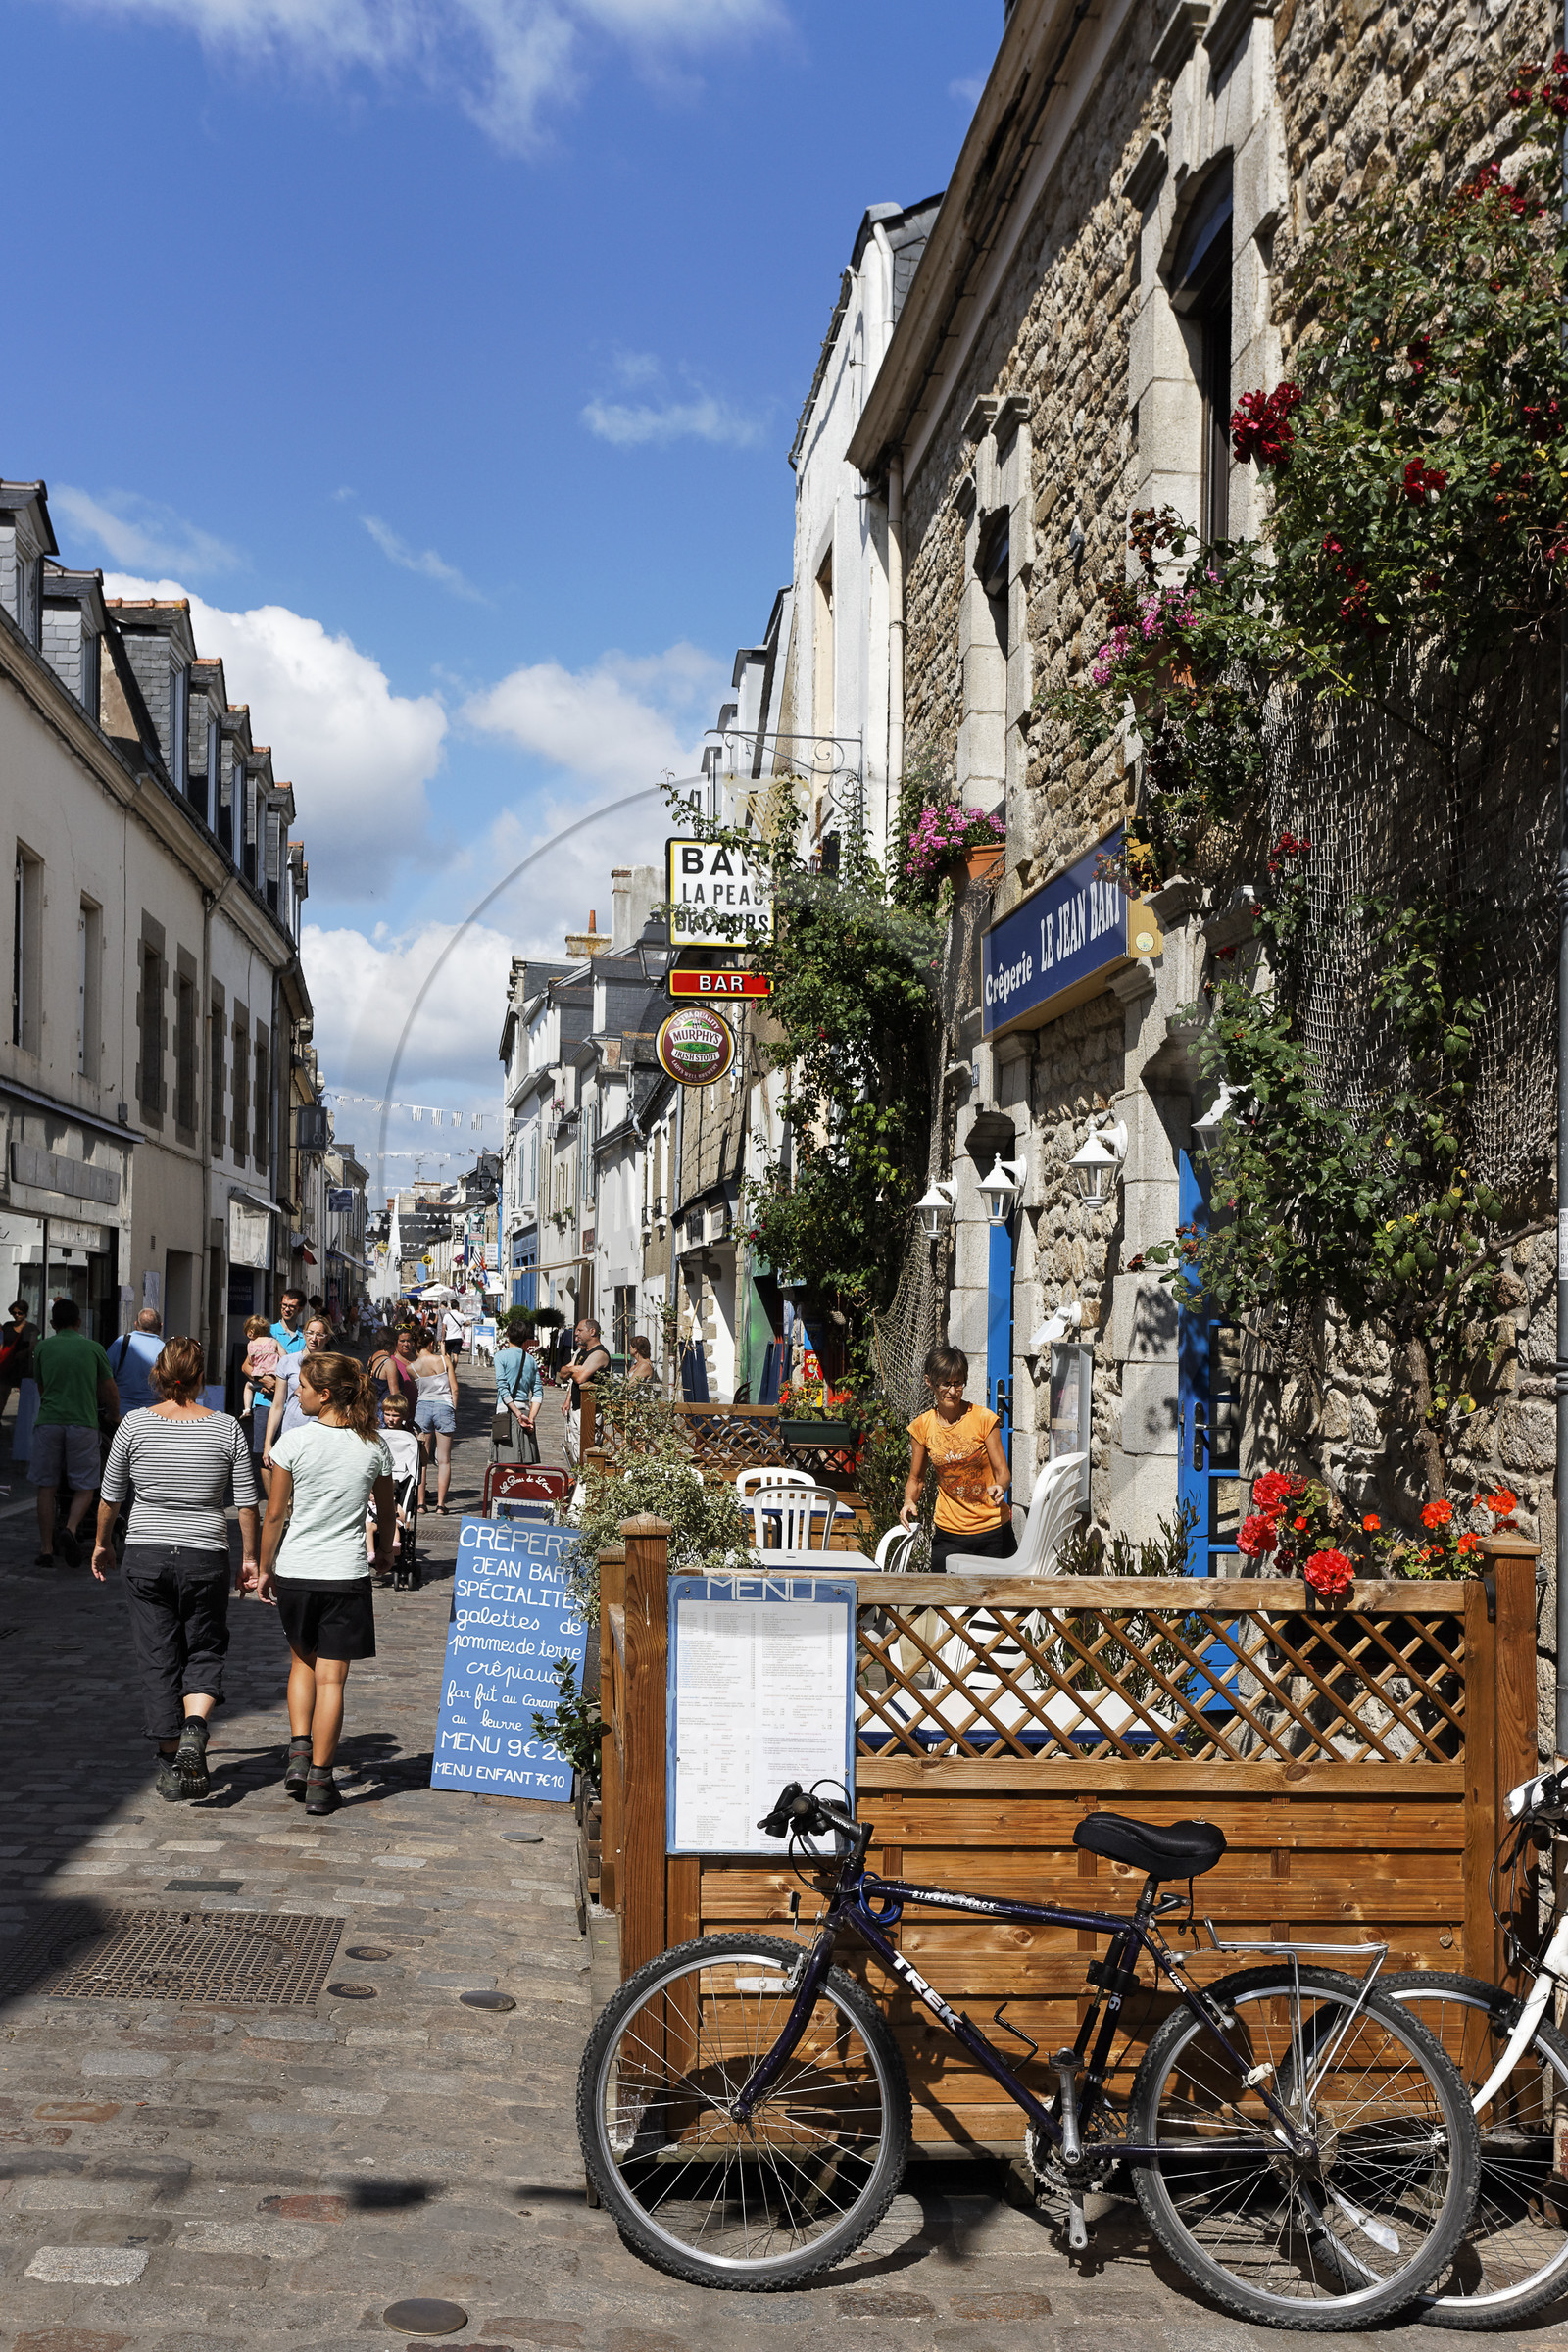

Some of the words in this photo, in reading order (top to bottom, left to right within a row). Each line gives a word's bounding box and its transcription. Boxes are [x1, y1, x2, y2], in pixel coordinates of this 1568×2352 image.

[682, 883, 706, 904] LA
[985, 950, 1033, 1006] Crêperie
[1040, 912, 1054, 973] LE
[1056, 888, 1087, 963] JEAN
[699, 975, 744, 992] BAR
[673, 1011, 693, 1027] EXTRA
[694, 1010, 720, 1029] QUALITY
[674, 1051, 695, 1060] IRISH
[696, 1053, 717, 1061] STOUT
[698, 1062, 719, 1079] BREWERY
[459, 1523, 583, 1557] CRÊPERI
[472, 1555, 522, 1582] JEAN
[528, 1562, 575, 1585] BART
[707, 1576, 816, 1602] MENU
[456, 1608, 541, 1632] galettes
[560, 1618, 584, 1637] de
[538, 1639, 582, 1661] terre
[447, 1680, 472, 1707] far
[474, 1683, 498, 1709] frit
[502, 1694, 517, 1704] au
[522, 1693, 573, 1710] Caram
[452, 1714, 467, 1725] au
[480, 1709, 524, 1732] beurre
[440, 1730, 501, 1754] MENU
[434, 1761, 473, 1778] MENU
[475, 1765, 534, 1786] ENFANT
[535, 1772, 565, 1788] 7€10
[831, 1815, 851, 1830] MATRIX
[911, 1890, 955, 1904] SINGLE
[959, 1897, 997, 1910] TRACK
[893, 1950, 964, 2033] TREK
[1168, 1971, 1189, 1993] USA
